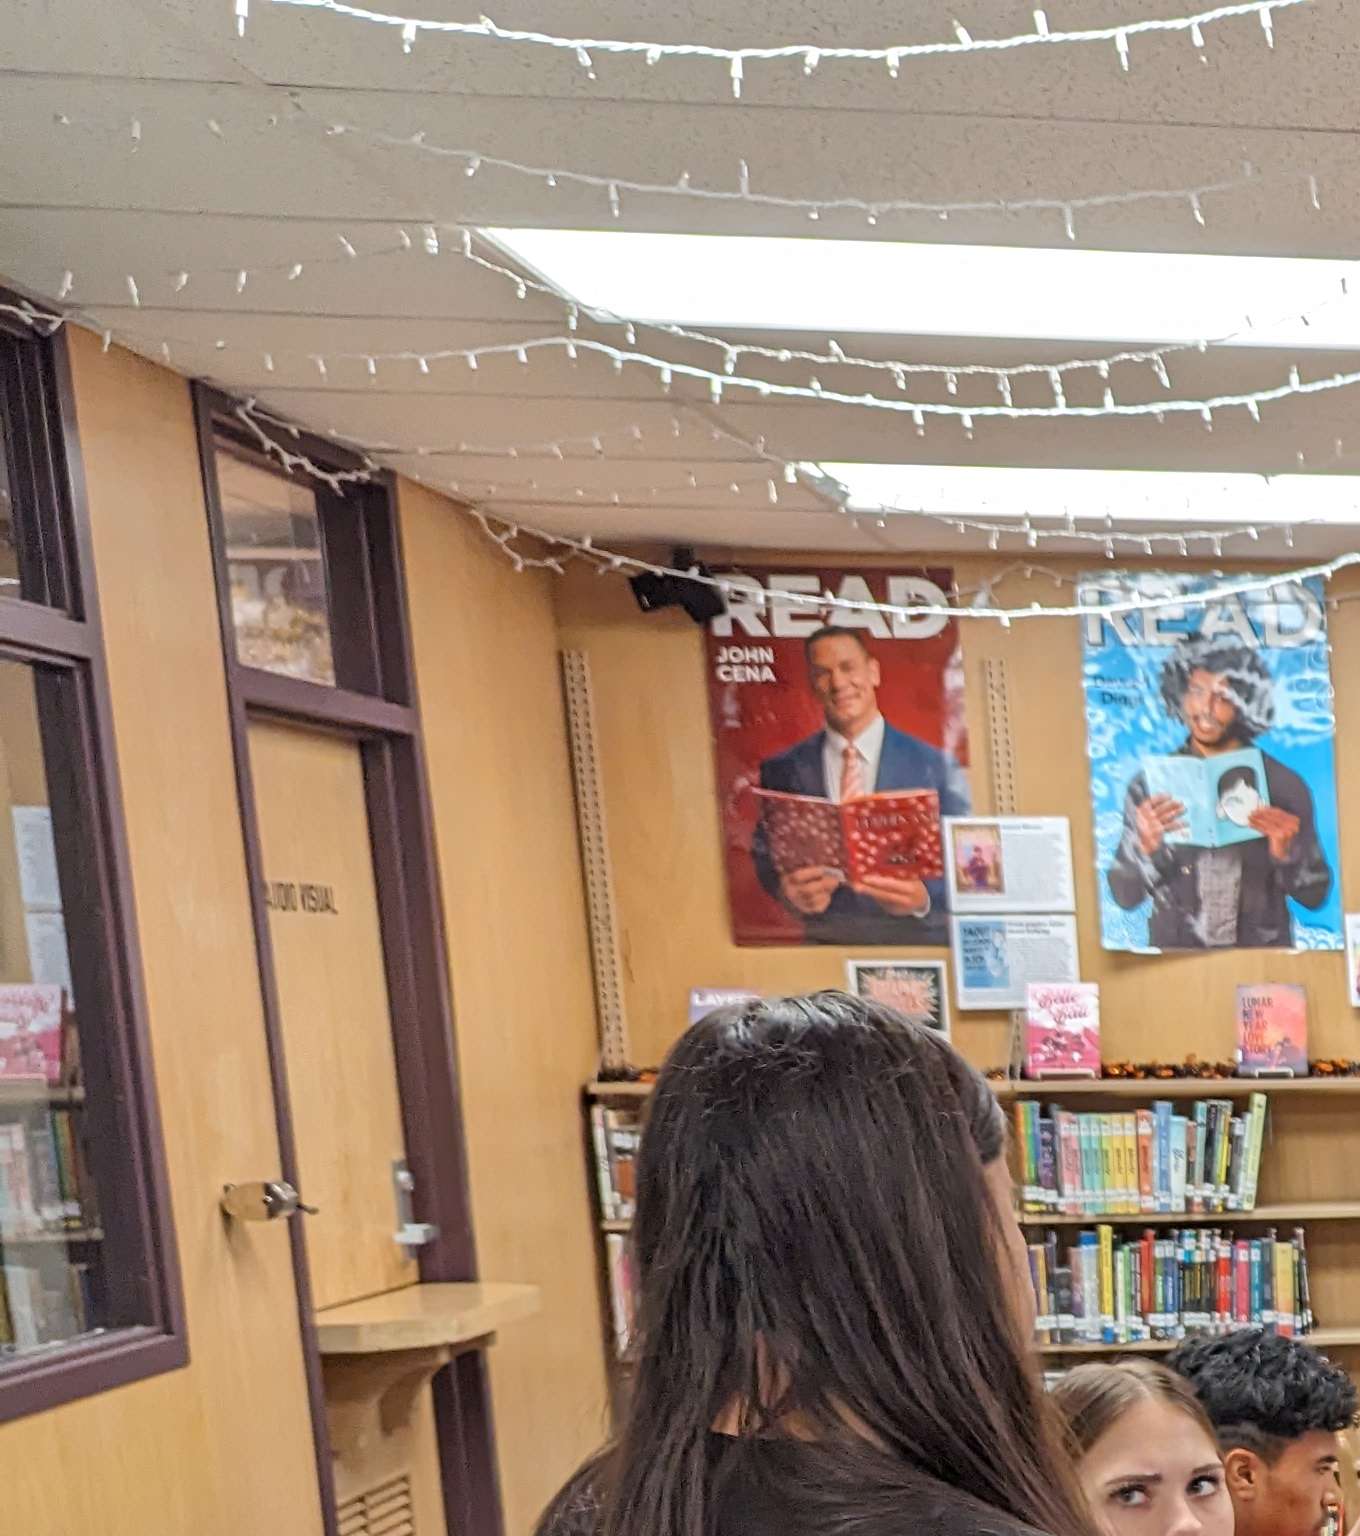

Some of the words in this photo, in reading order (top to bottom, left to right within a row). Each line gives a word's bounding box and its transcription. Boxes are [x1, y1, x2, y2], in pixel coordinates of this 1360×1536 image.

[711, 573, 950, 639] READ
[1084, 580, 1327, 649] READ
[716, 646, 774, 664] JOHN
[716, 665, 776, 683] CENA
[300, 883, 338, 914] VISUAL
